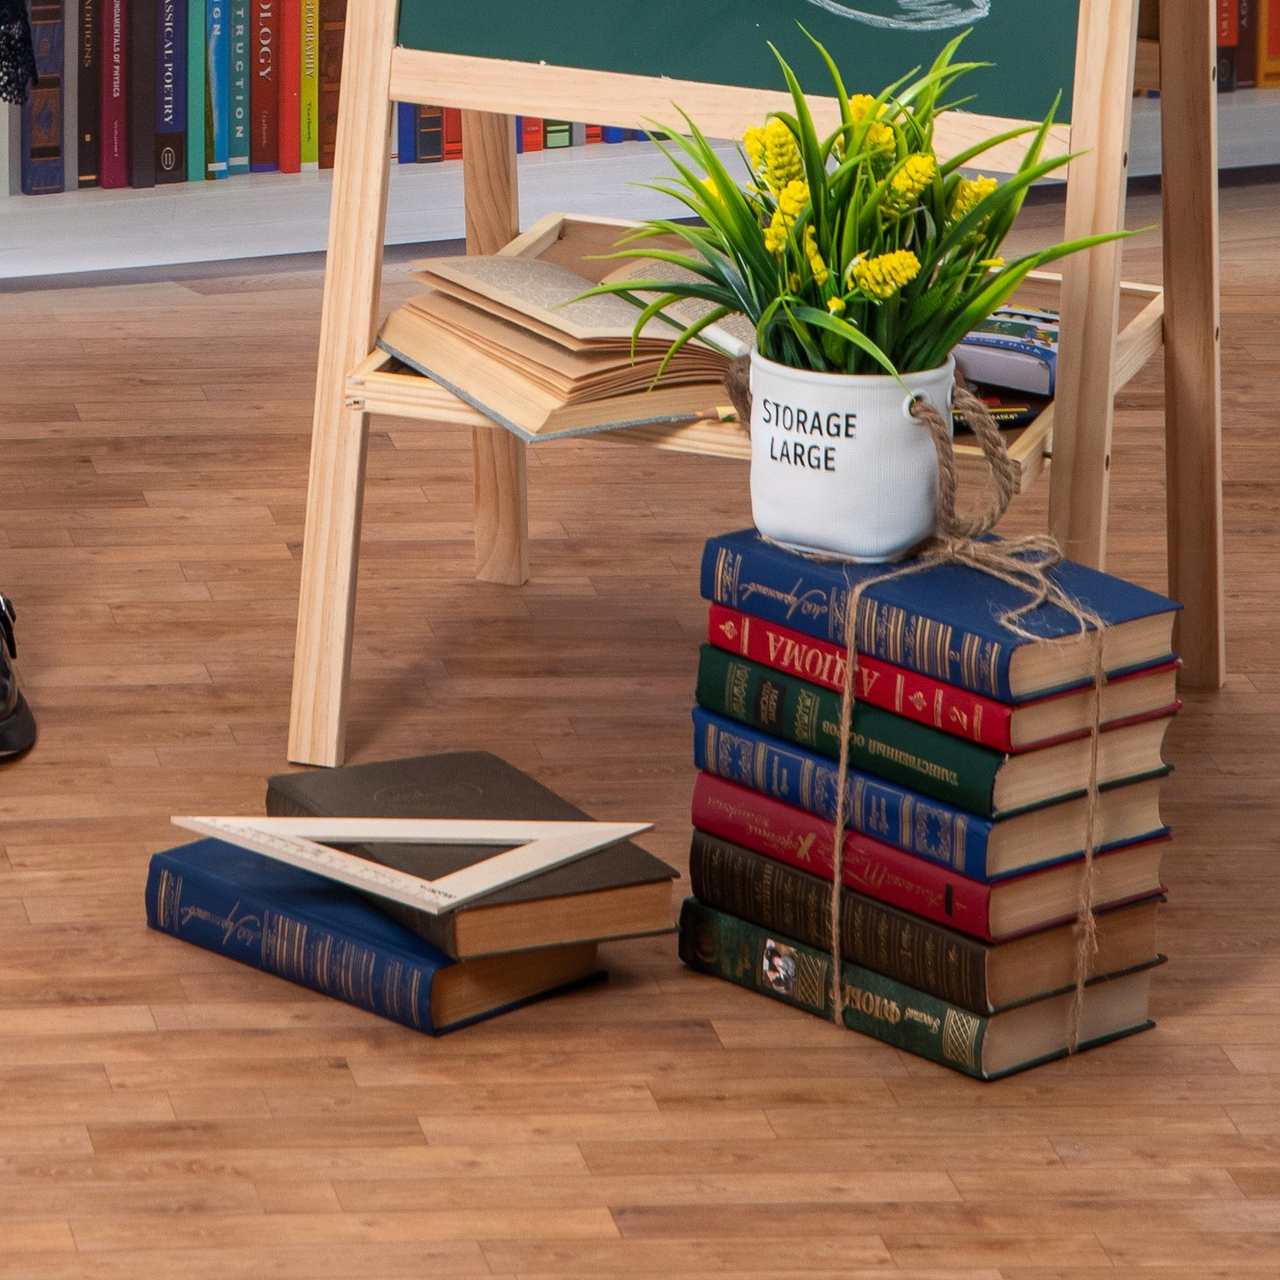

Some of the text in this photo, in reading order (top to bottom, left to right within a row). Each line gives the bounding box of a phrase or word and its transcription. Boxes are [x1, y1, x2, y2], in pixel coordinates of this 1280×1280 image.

[113, 54, 120, 63] OF
[112, 66, 120, 97] PHYSICS
[163, 63, 174, 125] POETRY
[763, 398, 857, 438] STORAGE
[770, 437, 836, 472] LARGE
[821, 719, 959, 786] ТАИНСТВЕННЫЙ ОСРОВ
